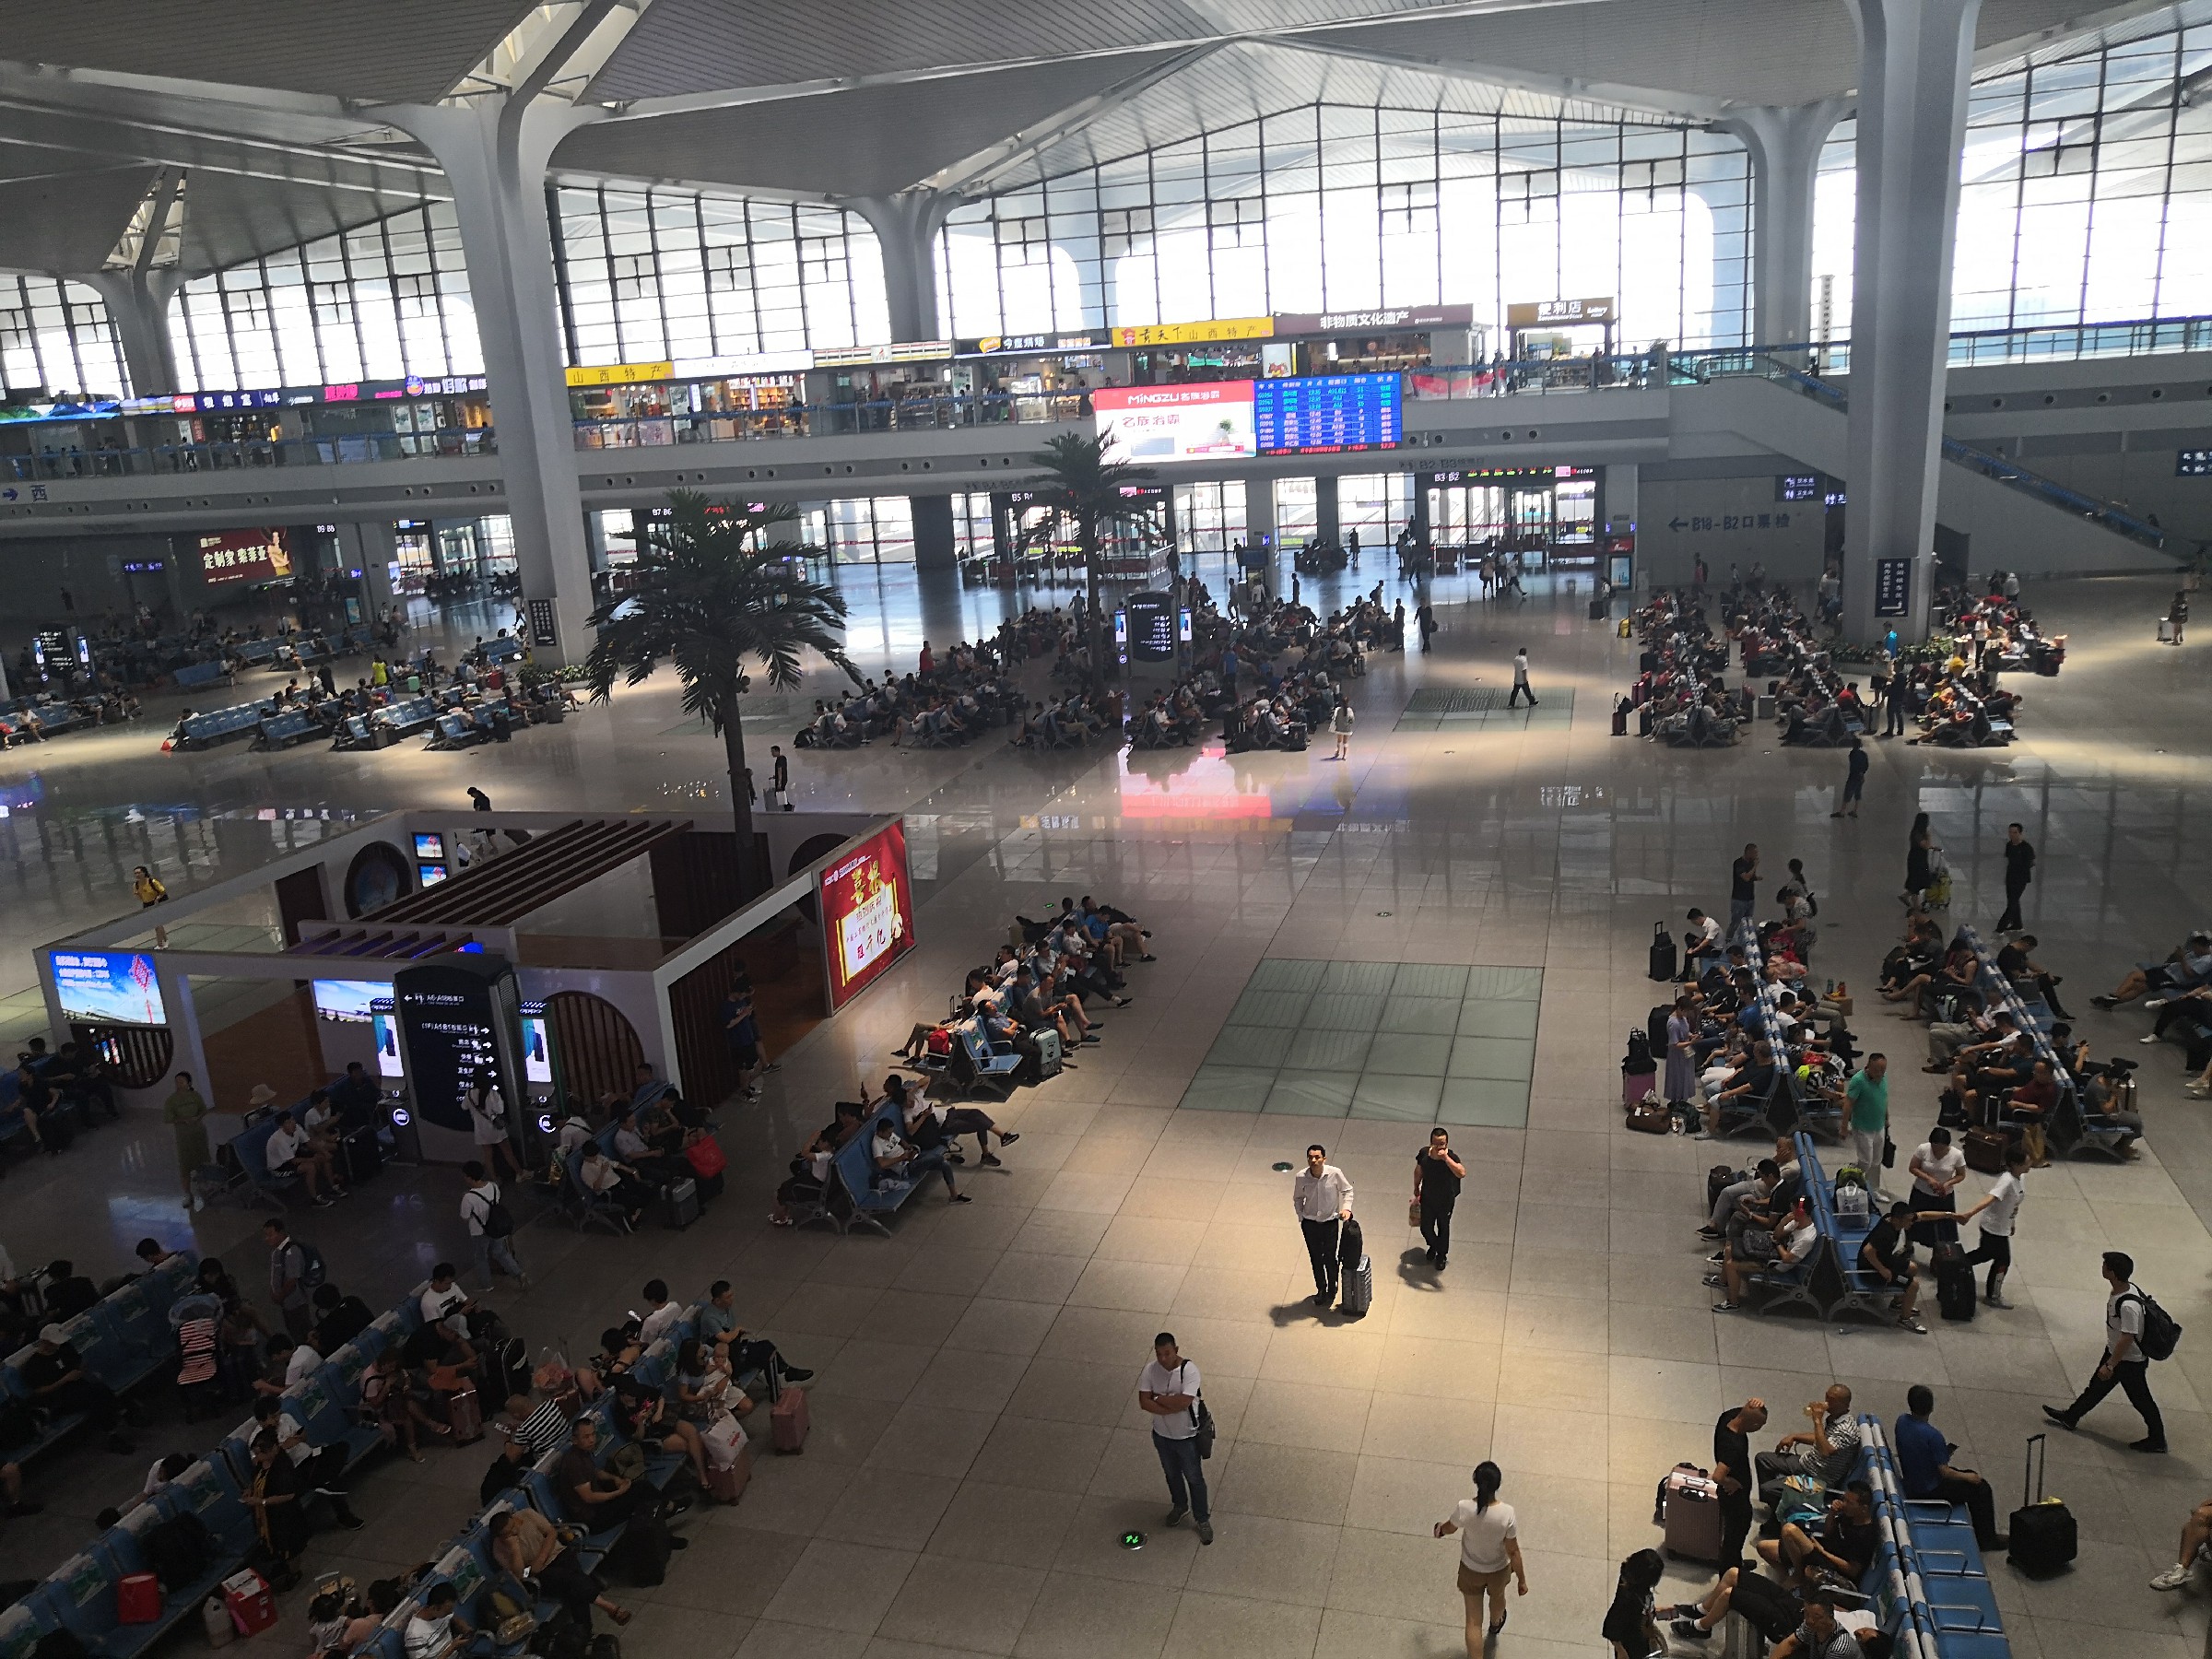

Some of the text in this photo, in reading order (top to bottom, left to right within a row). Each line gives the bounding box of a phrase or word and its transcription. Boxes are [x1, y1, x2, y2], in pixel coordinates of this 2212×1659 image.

[1537, 301, 1583, 316] 便利店
[1320, 310, 1409, 330] 非物质文化遗产
[572, 365, 662, 384] 山西特产
[31, 484, 47, 501] 西
